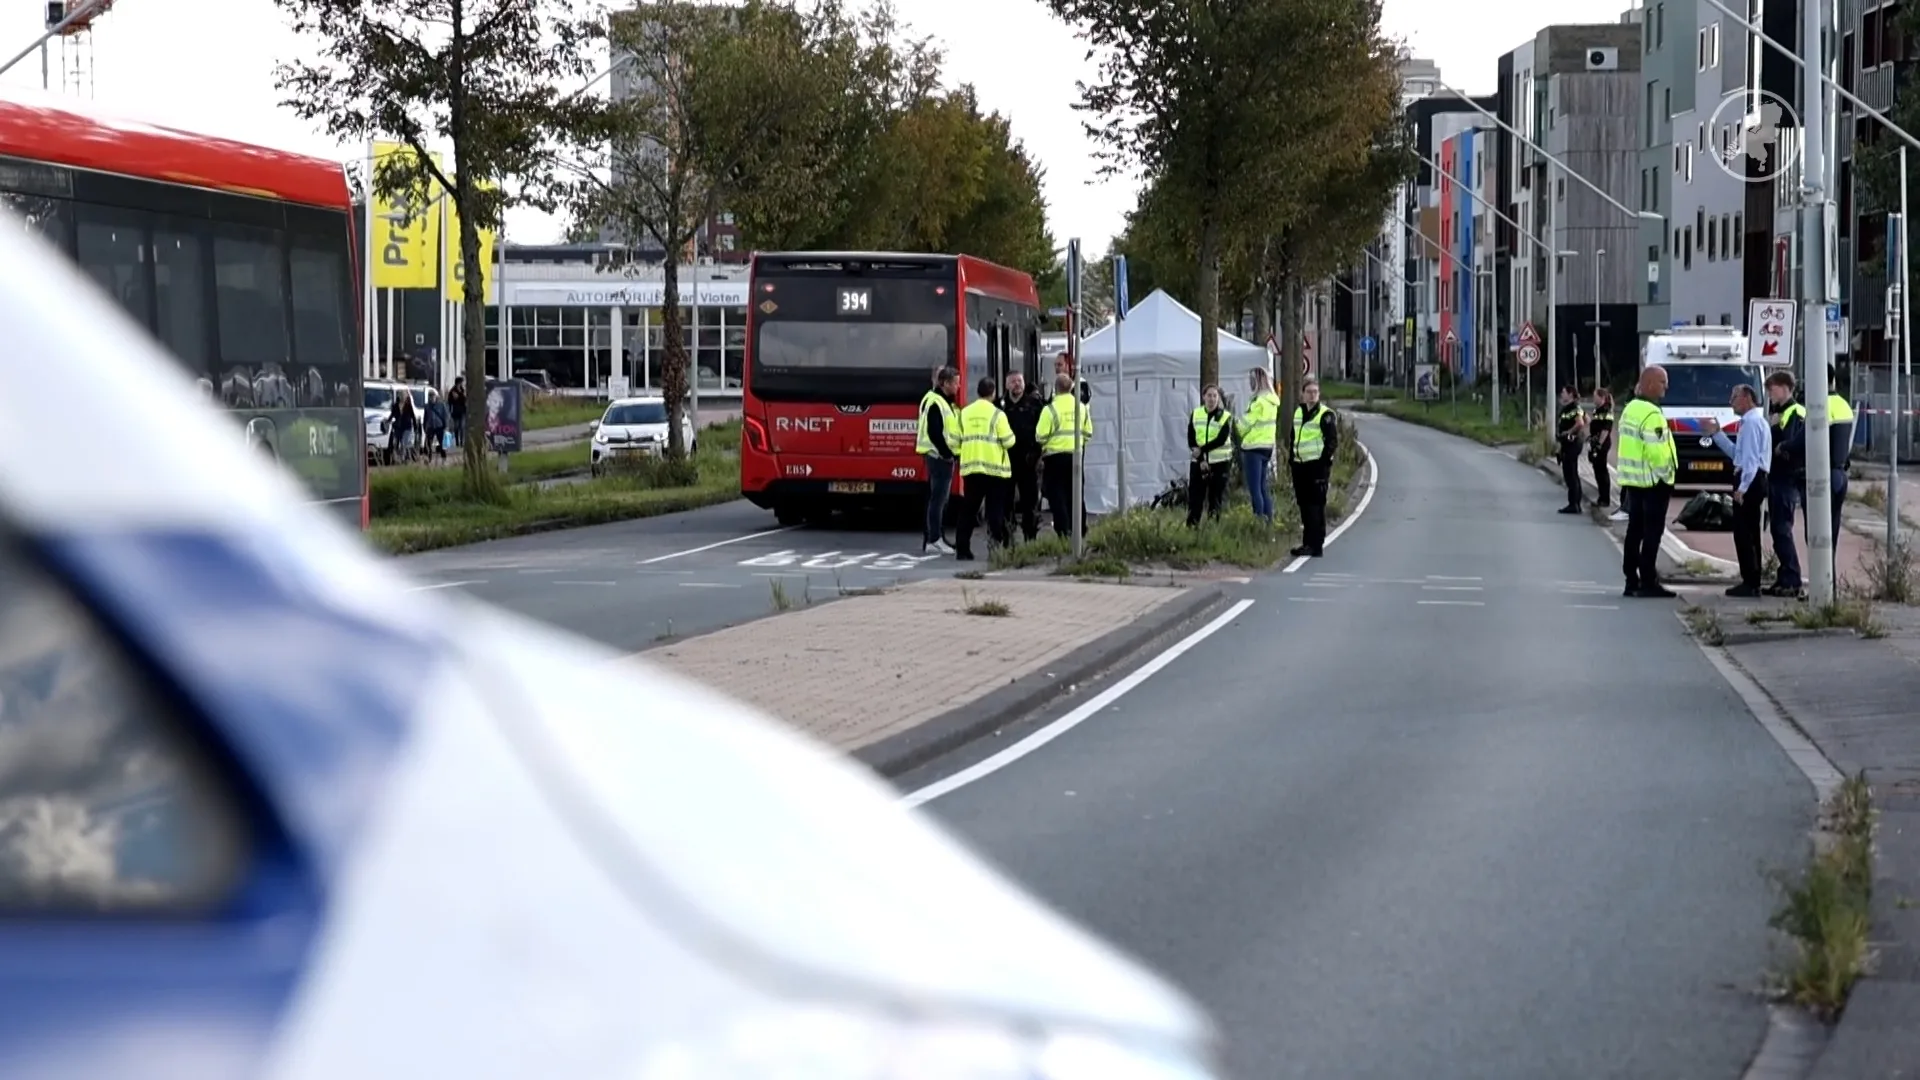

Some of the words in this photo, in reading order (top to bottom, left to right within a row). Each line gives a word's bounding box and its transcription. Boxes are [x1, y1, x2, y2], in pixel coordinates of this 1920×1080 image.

[700, 292, 740, 303] Vloten
[841, 291, 868, 311] 394
[1522, 349, 1536, 359] 30
[872, 421, 919, 431] MEERPLU
[785, 464, 806, 475] EBS
[891, 466, 917, 478] 4370
